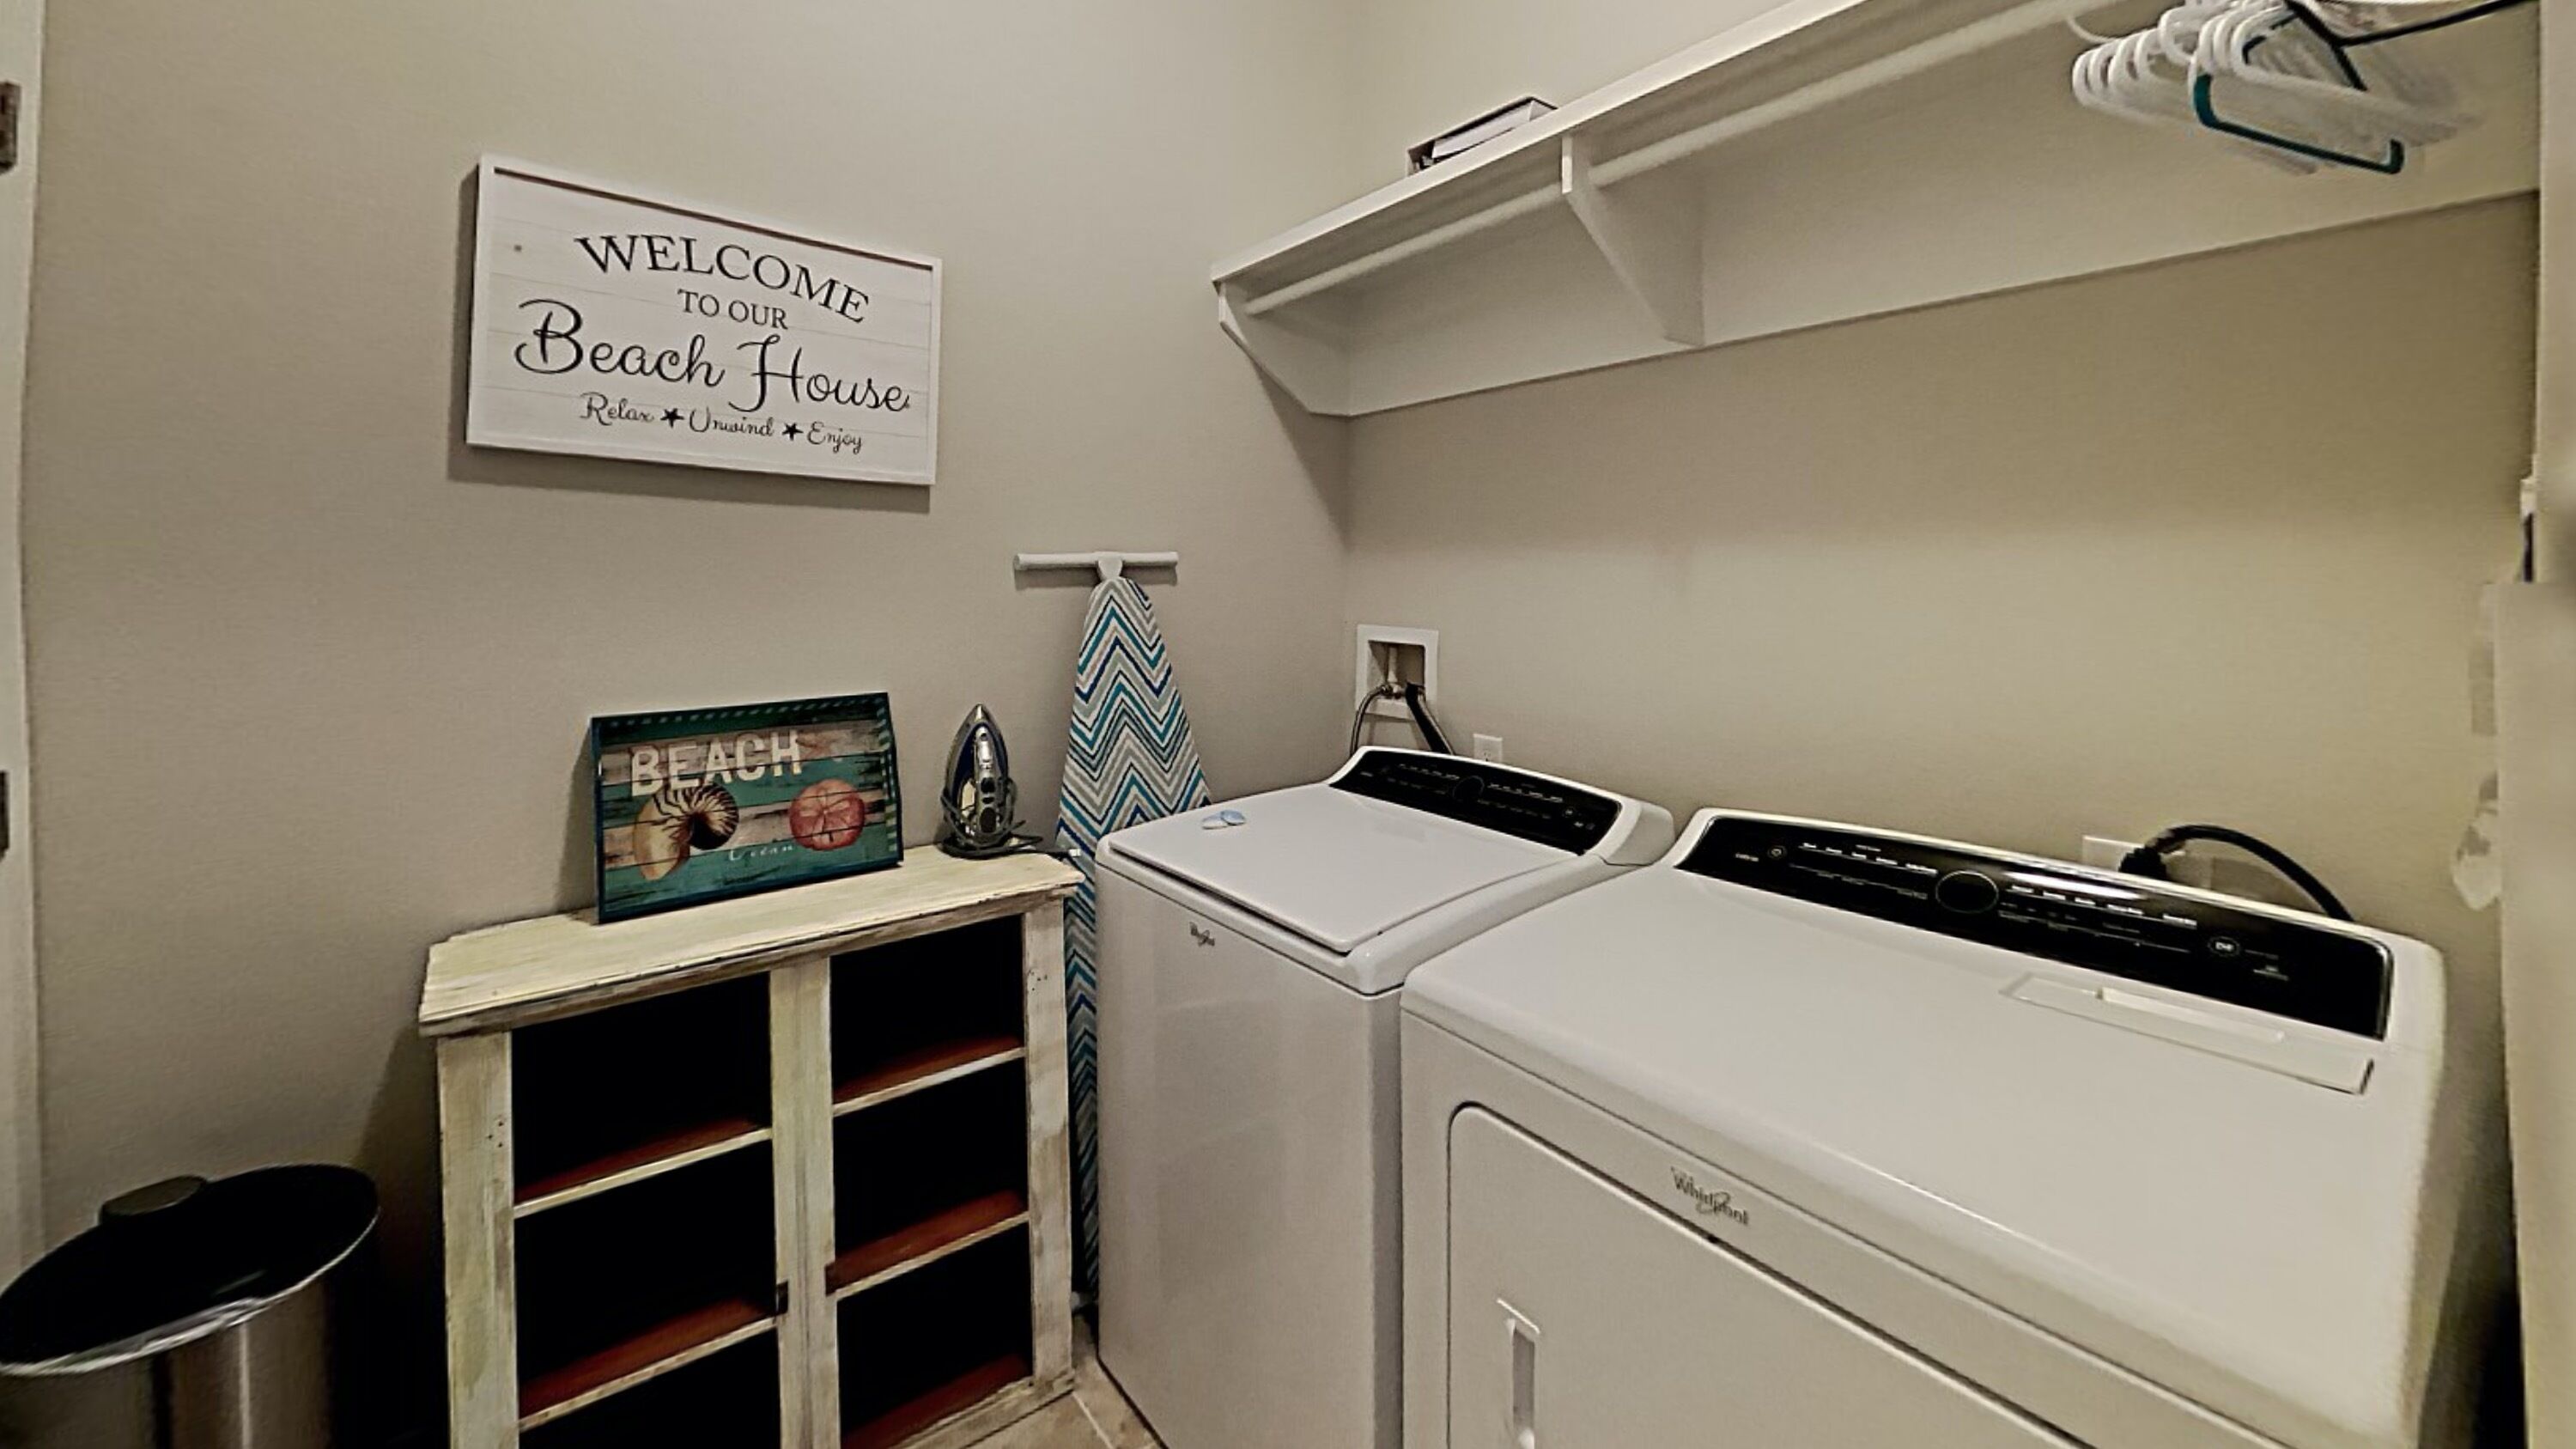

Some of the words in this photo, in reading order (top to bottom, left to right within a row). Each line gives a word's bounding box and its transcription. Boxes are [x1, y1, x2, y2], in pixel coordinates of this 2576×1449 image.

[574, 234, 869, 324] WELCOME
[677, 288, 720, 318] TO
[727, 300, 788, 330] OUR
[514, 298, 726, 388] Beach
[728, 333, 910, 414] House
[580, 392, 655, 427] Relax
[688, 406, 775, 438] Unwind
[805, 421, 863, 454] Enjoy
[632, 730, 802, 797] BEACH
[1669, 1166, 1749, 1226] Whirlpool
